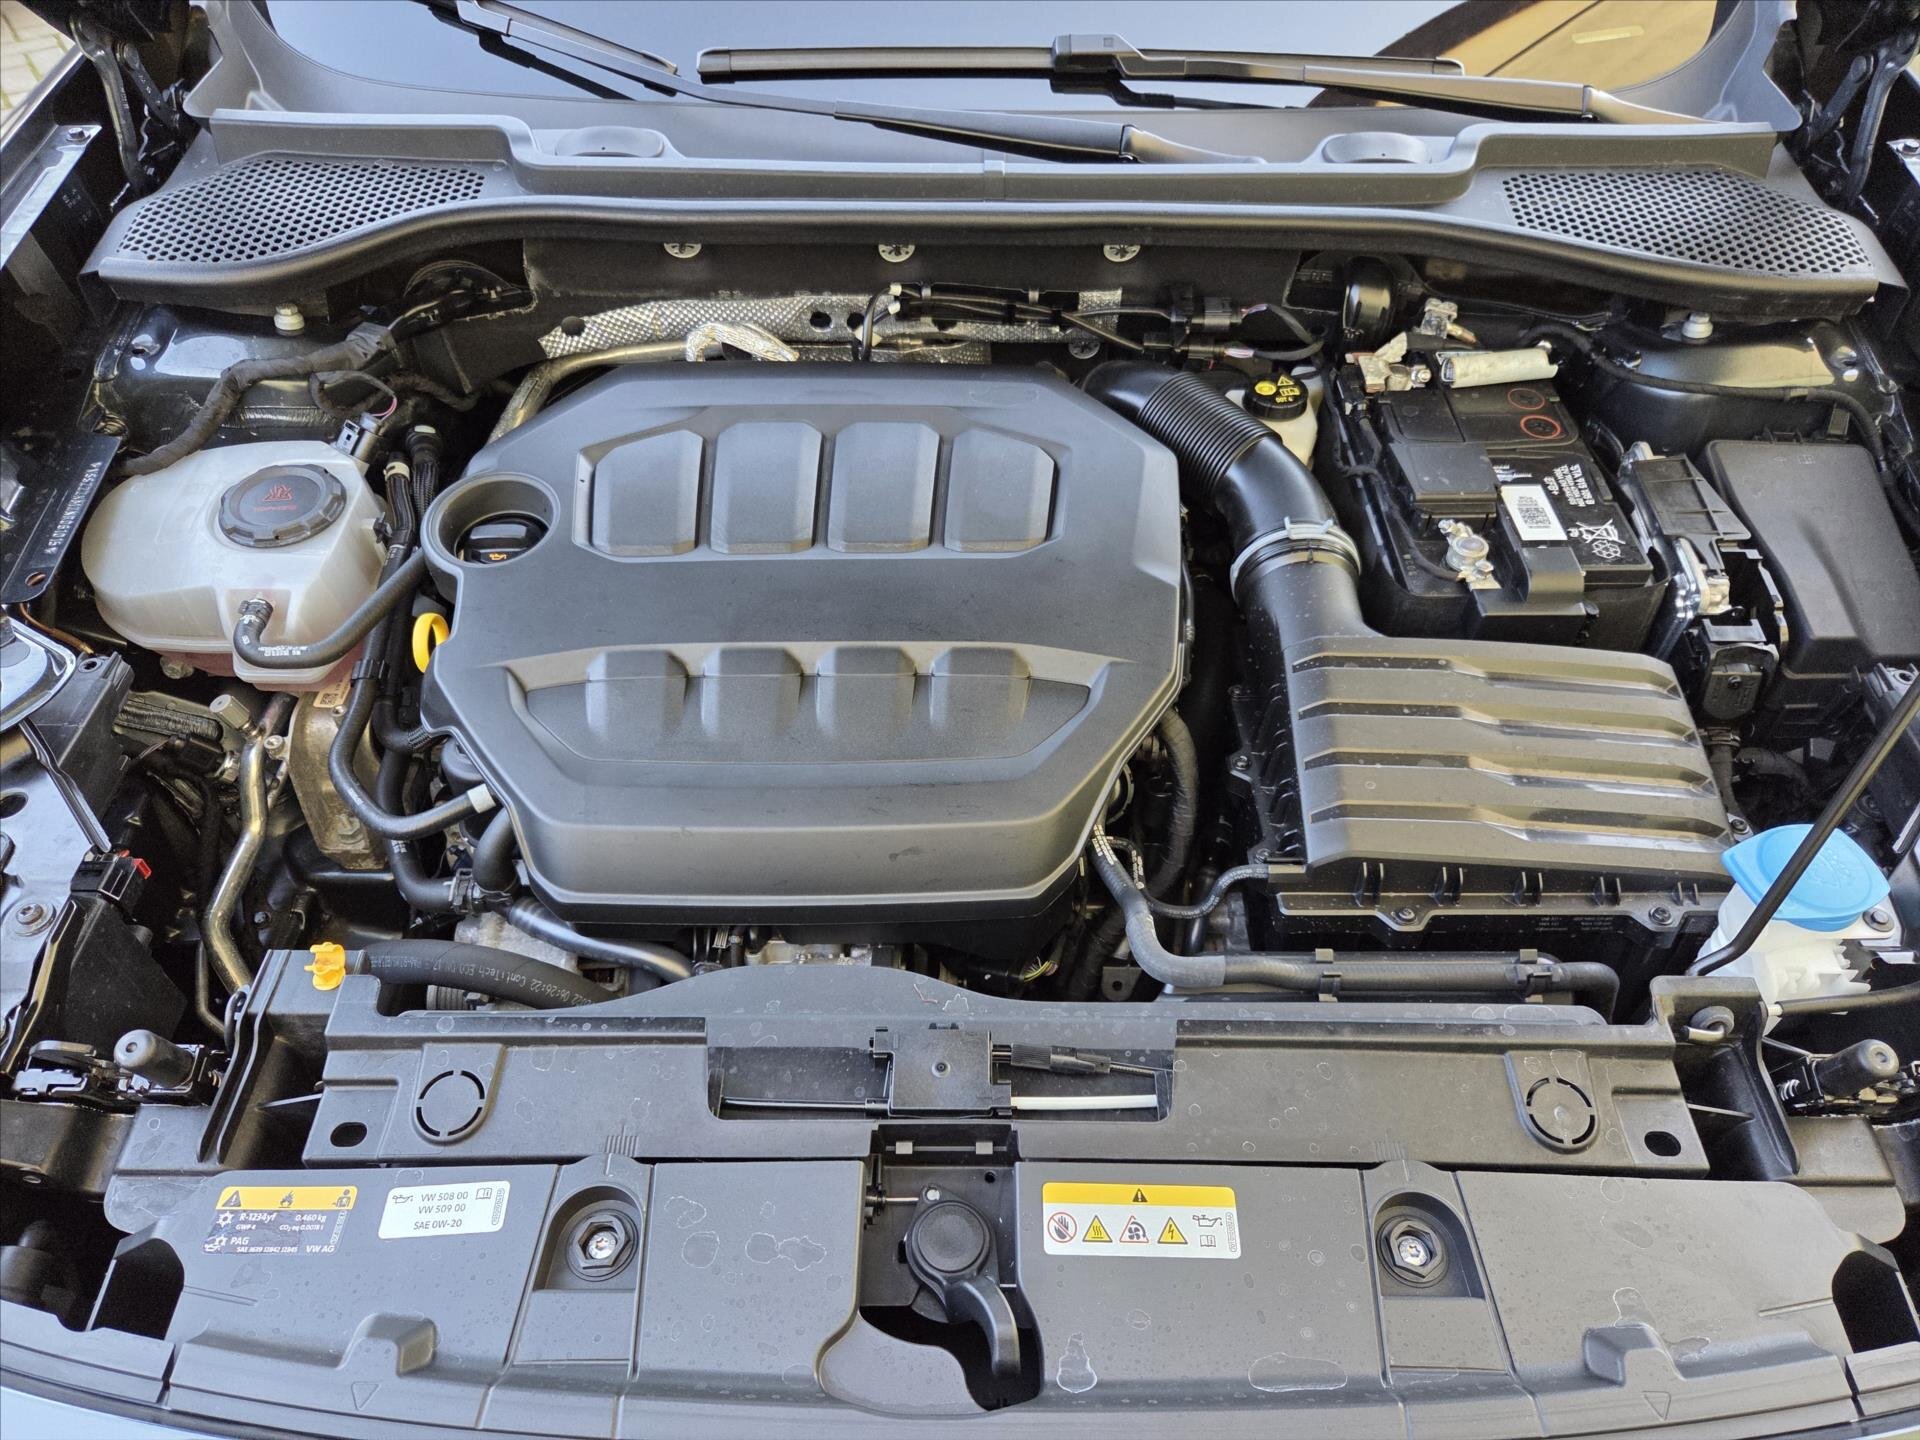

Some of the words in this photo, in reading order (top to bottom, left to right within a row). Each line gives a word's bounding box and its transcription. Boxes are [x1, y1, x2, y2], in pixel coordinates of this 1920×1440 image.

[477, 965, 528, 988] ContiTech
[421, 1192, 437, 1202] VW
[437, 1191, 455, 1201] 508
[456, 1190, 469, 1200] 00
[418, 1205, 434, 1214] VW
[435, 1204, 453, 1213] 509
[454, 1203, 467, 1212] 00
[239, 1212, 277, 1224] R-1234yf
[317, 1214, 327, 1223] kg
[413, 1220, 431, 1230] SAE
[432, 1218, 463, 1229] 0W-20
[230, 1236, 251, 1246] PAG
[306, 1244, 322, 1253] VW
[321, 1244, 336, 1253] AG
